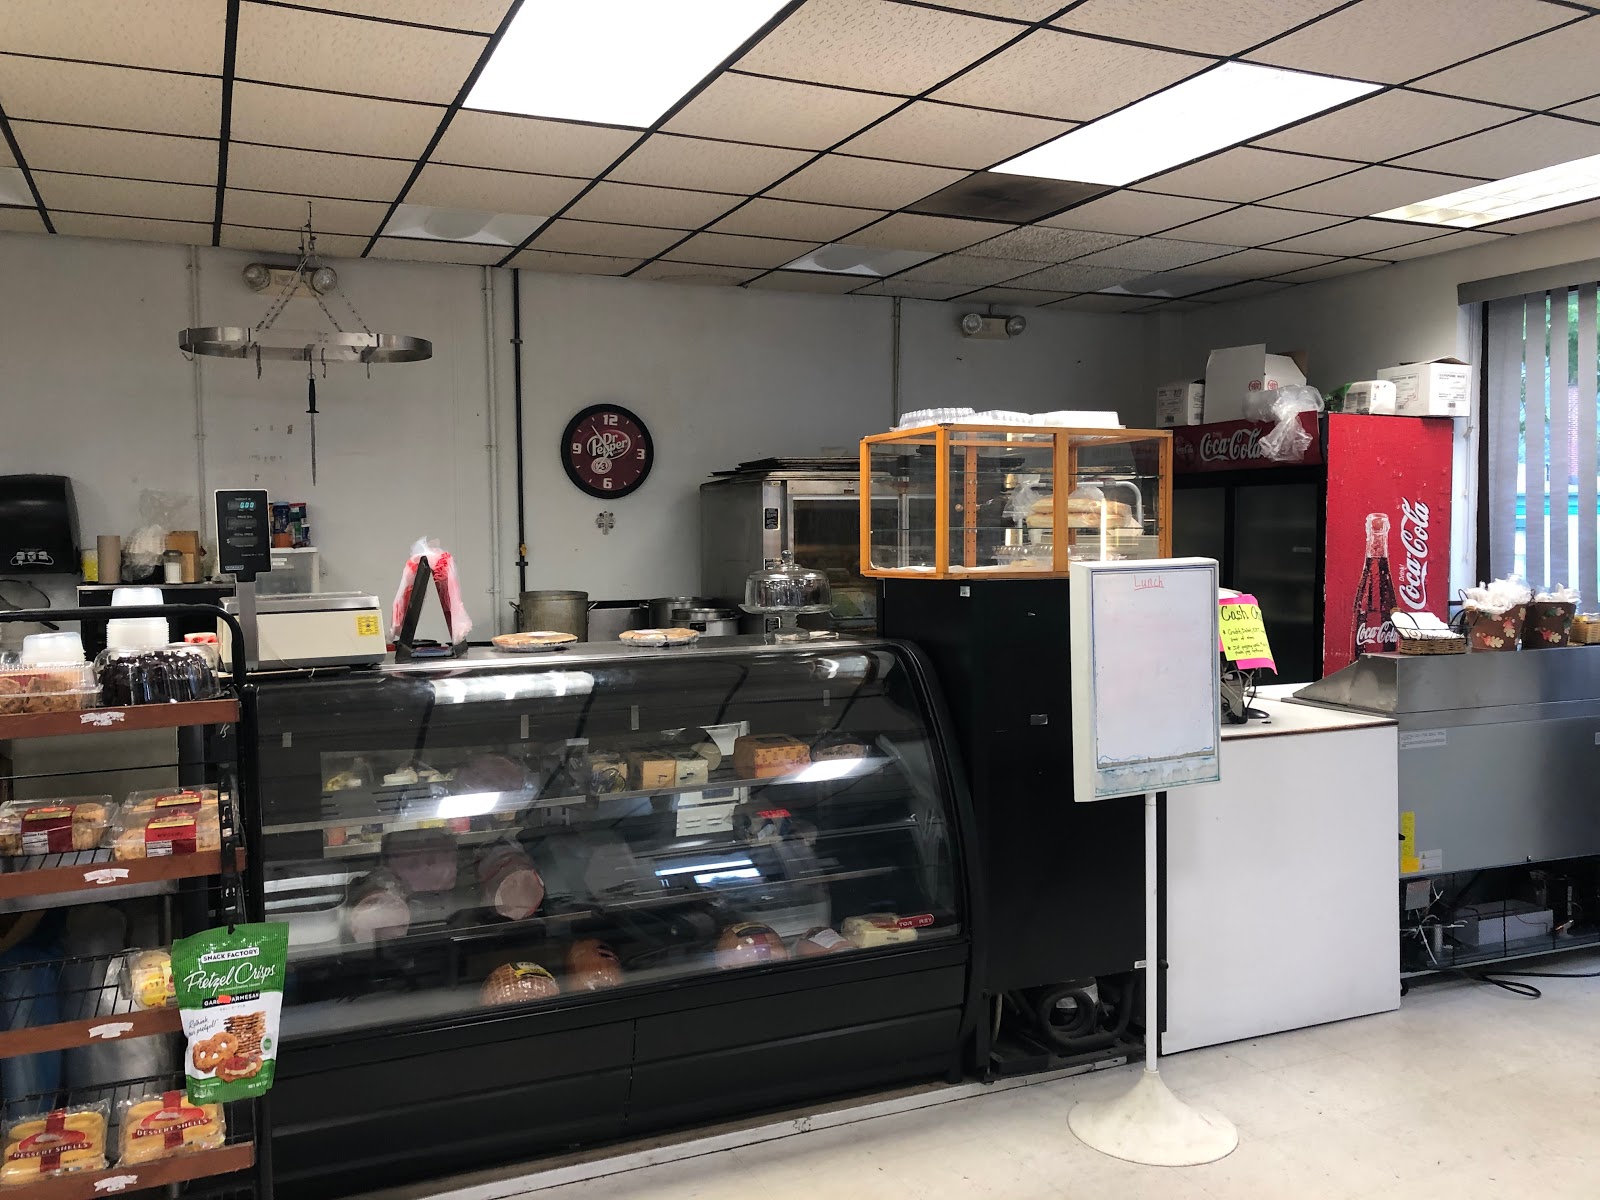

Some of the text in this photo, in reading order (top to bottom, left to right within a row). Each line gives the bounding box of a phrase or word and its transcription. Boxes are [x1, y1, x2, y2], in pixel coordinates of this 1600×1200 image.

[603, 414, 618, 426] 12
[603, 433, 618, 445] Dr
[1200, 428, 1263, 462] Coca-Cola
[572, 442, 582, 455] 9
[636, 448, 646, 460] 3
[602, 477, 613, 489] 6
[1399, 497, 1430, 610] Coca-Cola
[1133, 575, 1164, 589] Lunch
[1221, 604, 1249, 622] Cash
[1356, 621, 1399, 646] Coca-Cola
[203, 948, 259, 962] SNACK FACTORY
[183, 961, 276, 997] Pretzel Crisps
[231, 992, 260, 1003] ARMESAN
[136, 1118, 209, 1137] DESSERT SHELLS
[13, 1141, 89, 1159] DESSERT SHELLS
